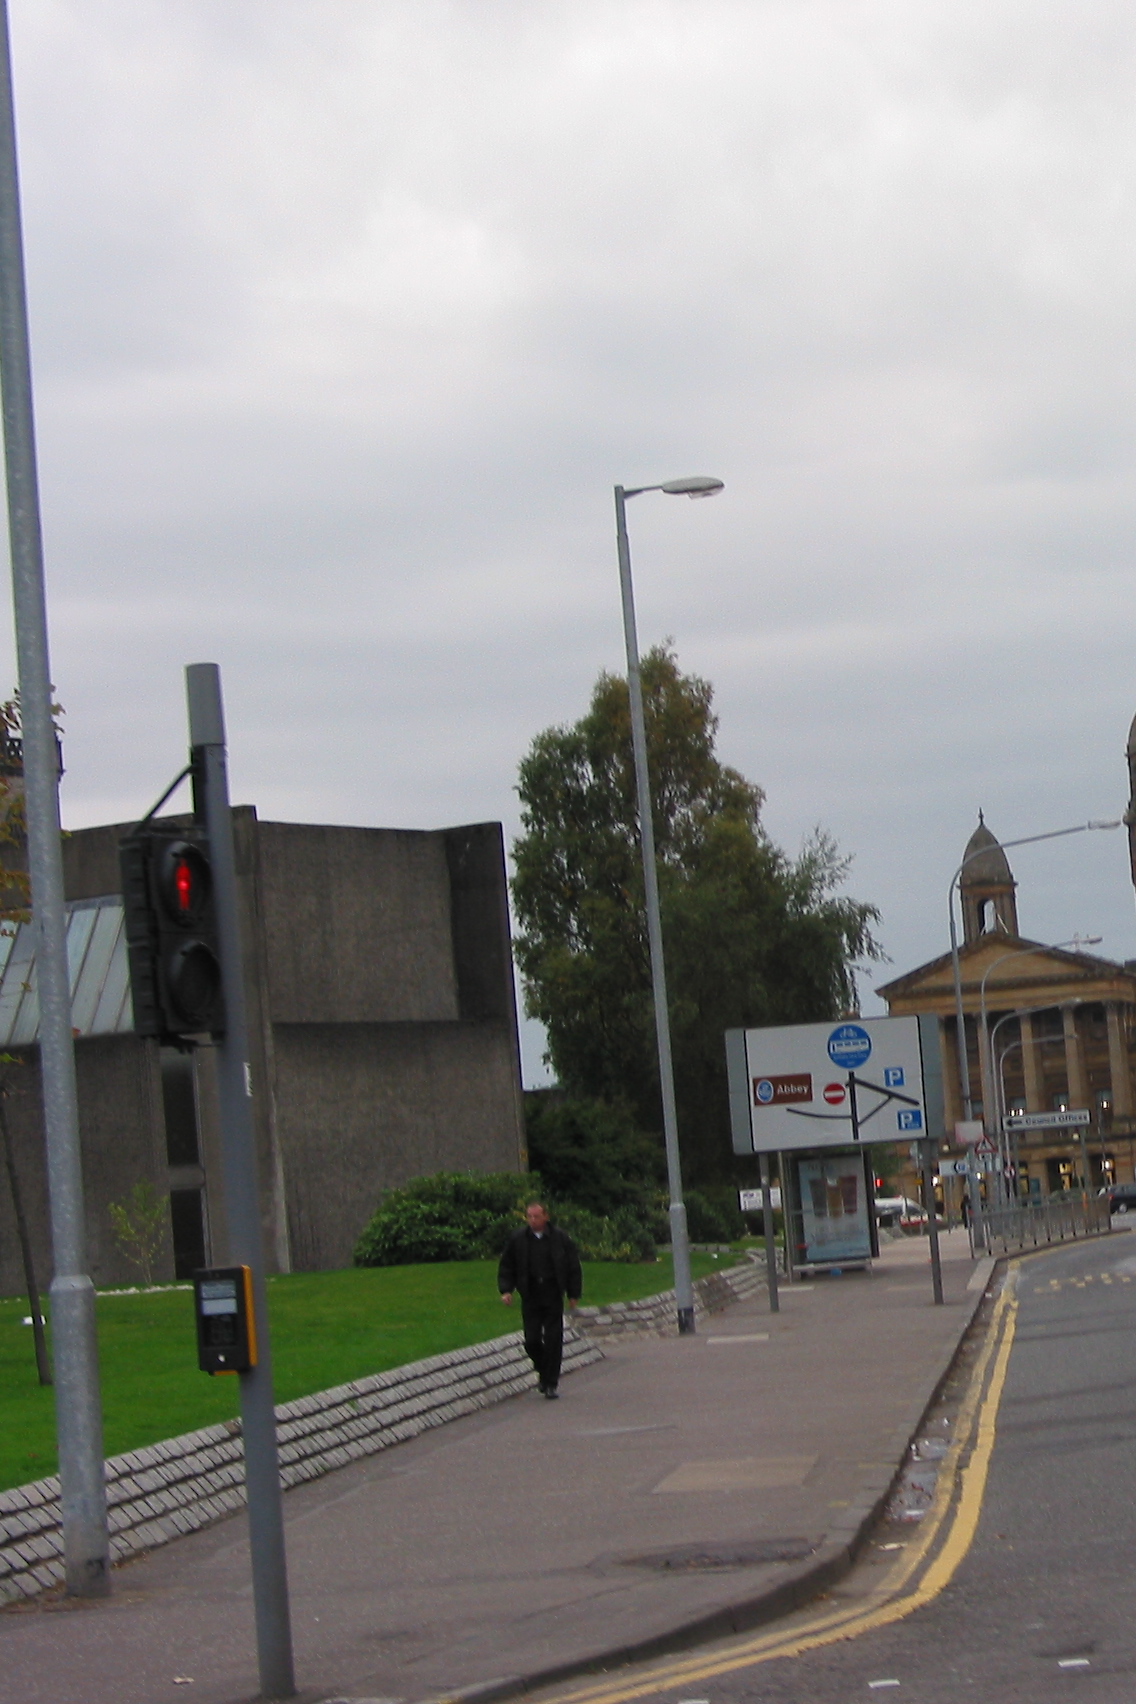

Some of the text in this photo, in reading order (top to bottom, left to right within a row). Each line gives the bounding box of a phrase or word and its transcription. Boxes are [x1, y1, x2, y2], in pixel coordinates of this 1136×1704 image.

[888, 1069, 901, 1086] P
[777, 1083, 809, 1096] Abbey
[900, 1112, 913, 1129] P
